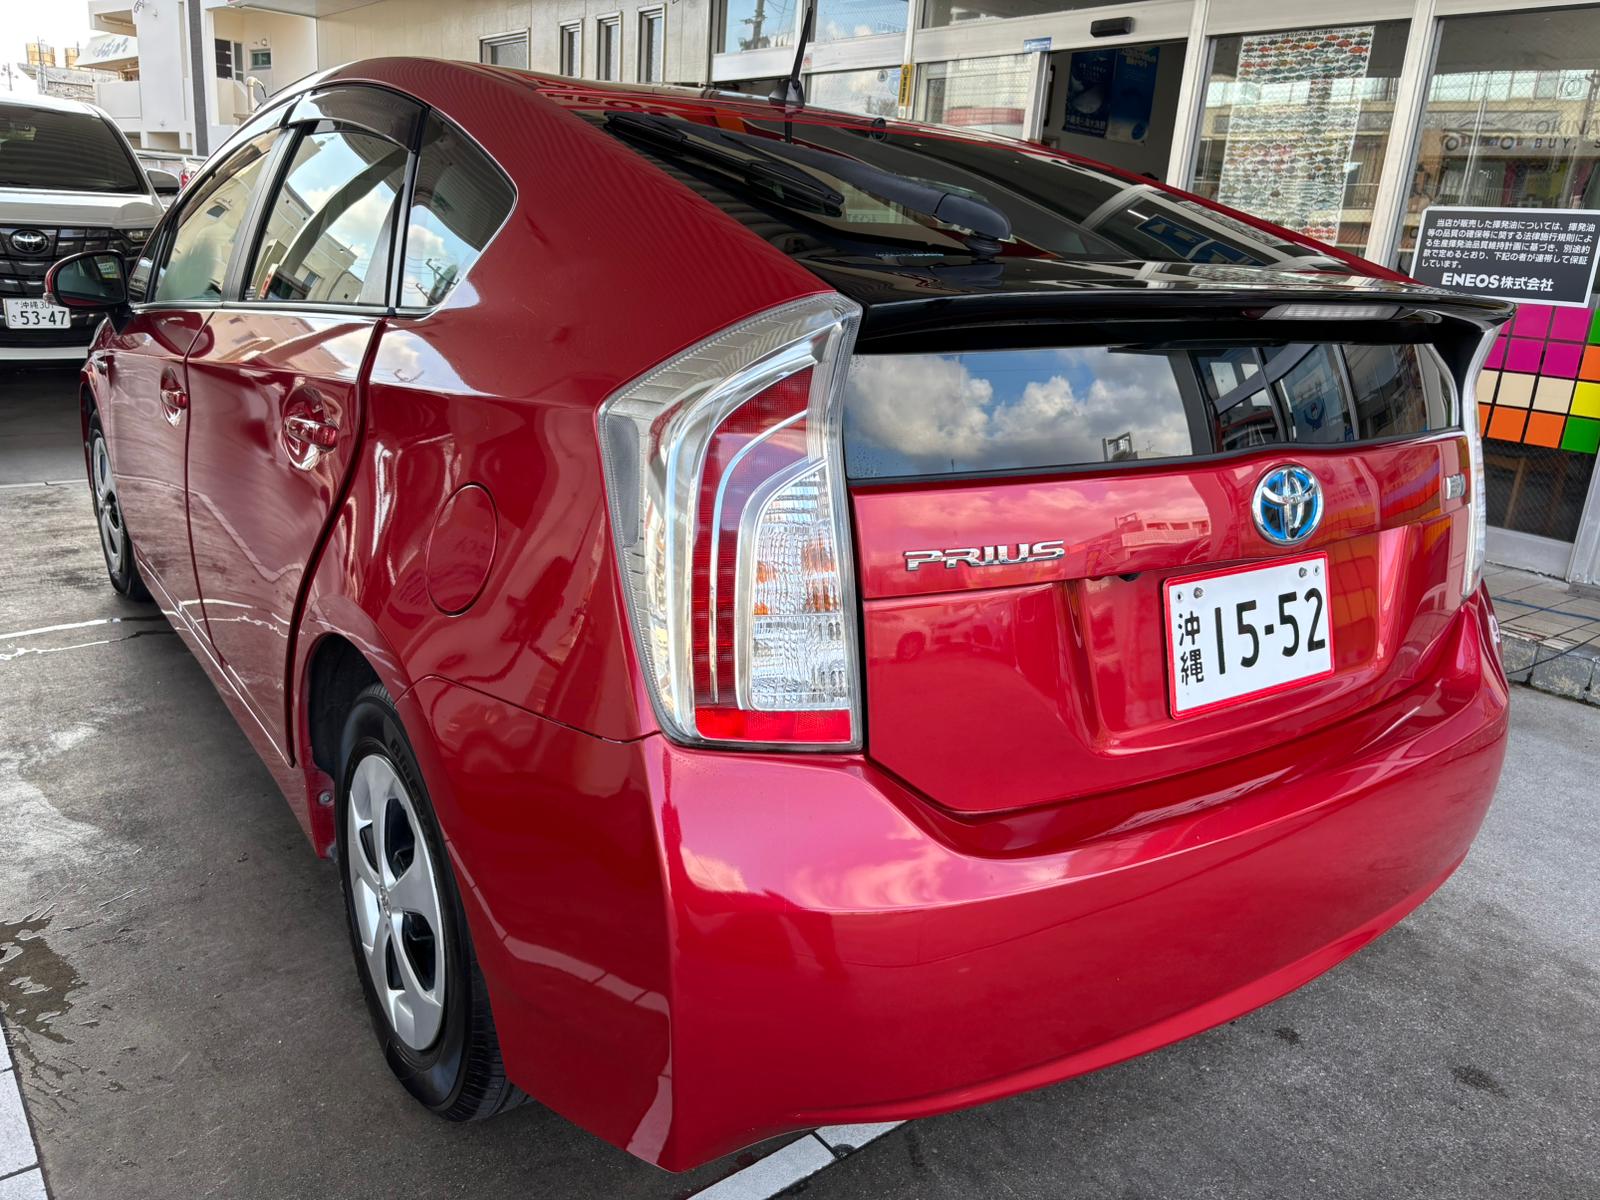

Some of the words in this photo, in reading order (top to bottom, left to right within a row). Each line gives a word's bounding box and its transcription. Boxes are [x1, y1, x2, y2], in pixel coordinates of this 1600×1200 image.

[1436, 218, 1596, 232] 当店が販売した揮発油については、揮発油
[1427, 228, 1593, 243] 等の品質の確保等に関する法律施行規則によ
[1421, 259, 1462, 268] しています。
[20, 311, 66, 325] 53-47
[903, 540, 1066, 572] PRIUS
[1214, 587, 1326, 675] 15-52
[1177, 610, 1205, 686] 沖縄
